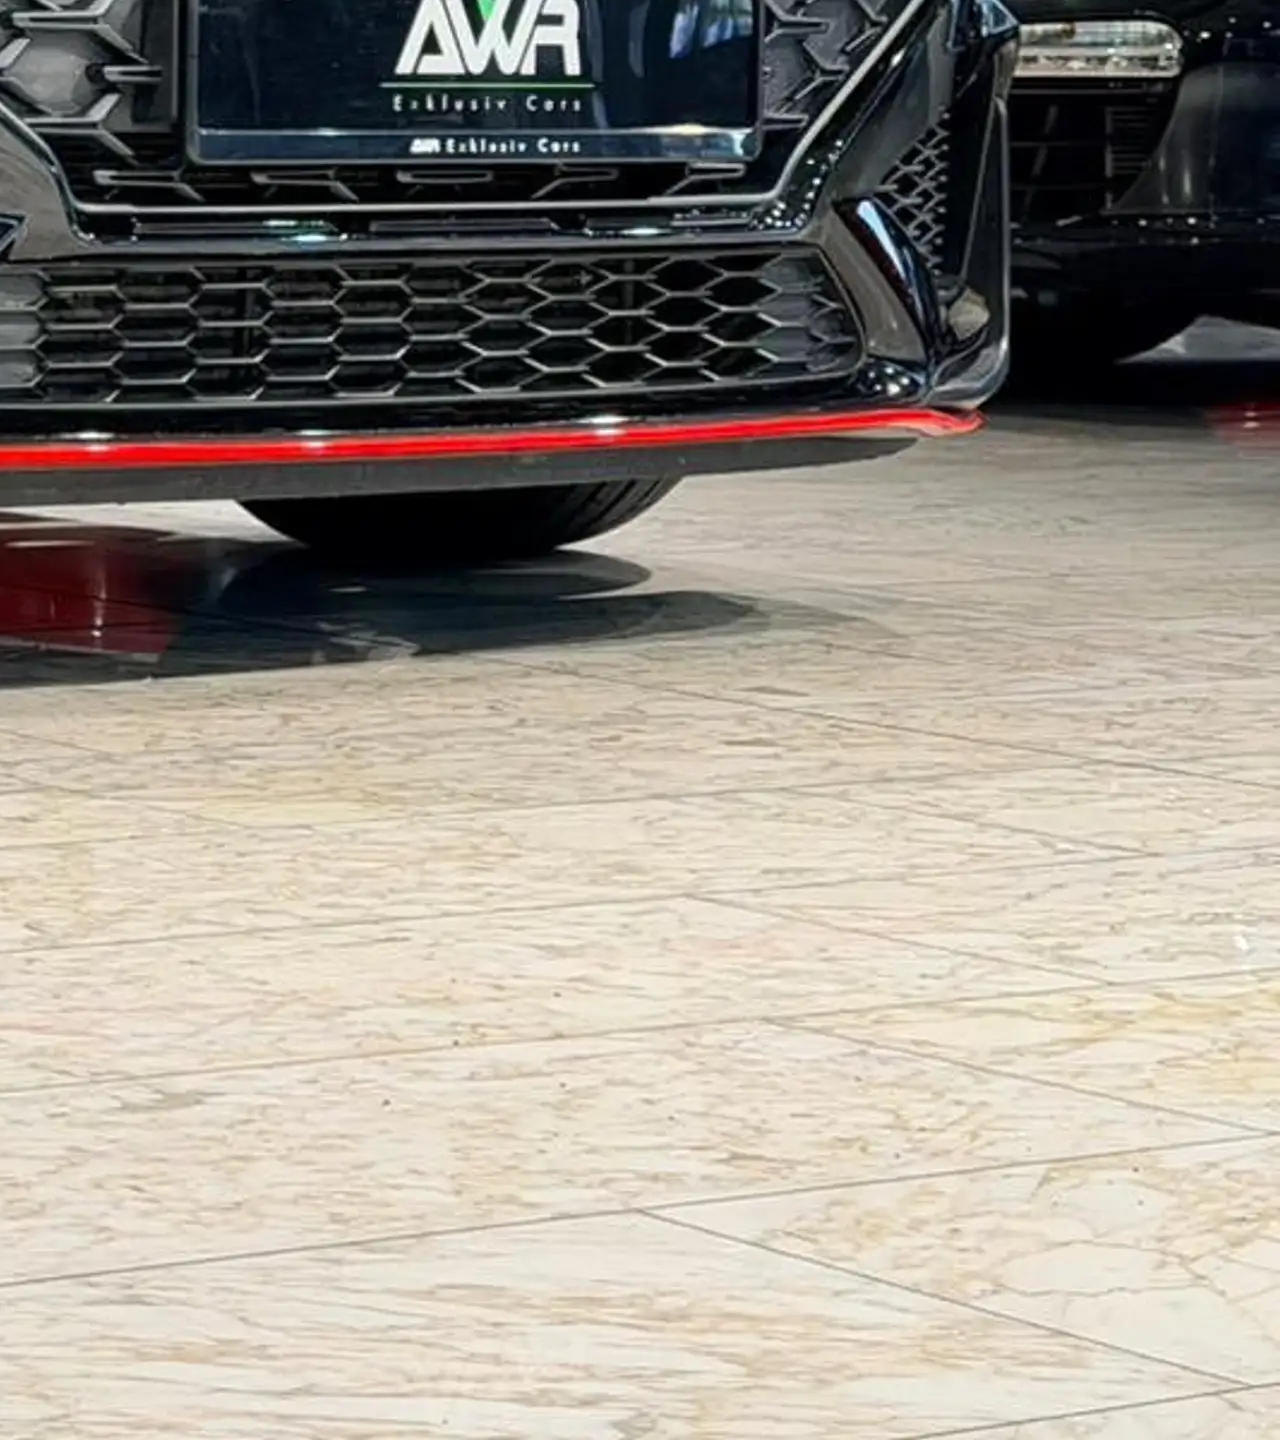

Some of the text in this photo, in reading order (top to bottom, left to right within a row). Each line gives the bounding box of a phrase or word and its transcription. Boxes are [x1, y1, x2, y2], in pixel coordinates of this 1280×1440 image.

[392, 93, 581, 112] Exklusiv Cars
[444, 138, 527, 154] Exklusiv
[537, 138, 580, 154] Cars
